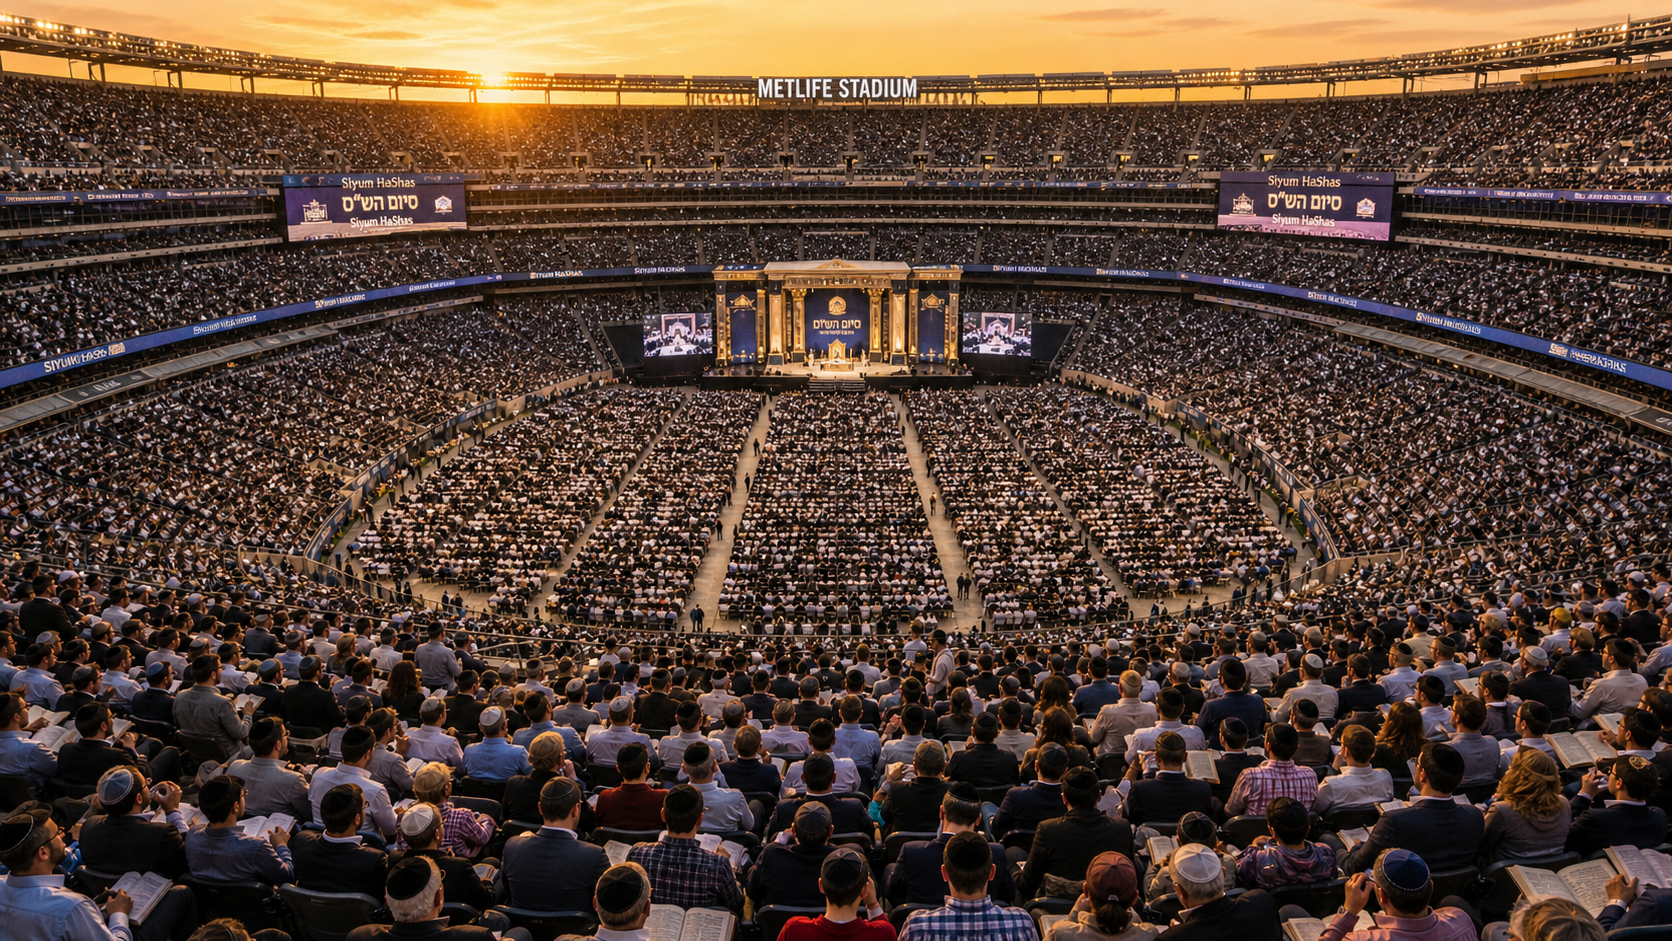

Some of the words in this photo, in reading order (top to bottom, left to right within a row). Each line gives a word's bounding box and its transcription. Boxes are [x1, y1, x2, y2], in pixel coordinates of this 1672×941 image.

[758, 78, 833, 98] METLIFE
[838, 78, 917, 98] STADIUM
[341, 177, 374, 191] Siyum
[376, 176, 416, 188] HaShas
[1268, 175, 1299, 188] Siyum
[1302, 176, 1341, 188] HaShas
[388, 194, 419, 211] סיום
[1310, 195, 1342, 211] סיום
[350, 217, 378, 231] Siyum
[380, 215, 414, 226] HaShas
[1272, 214, 1300, 227] Siyum
[1301, 215, 1335, 227] HaShas
